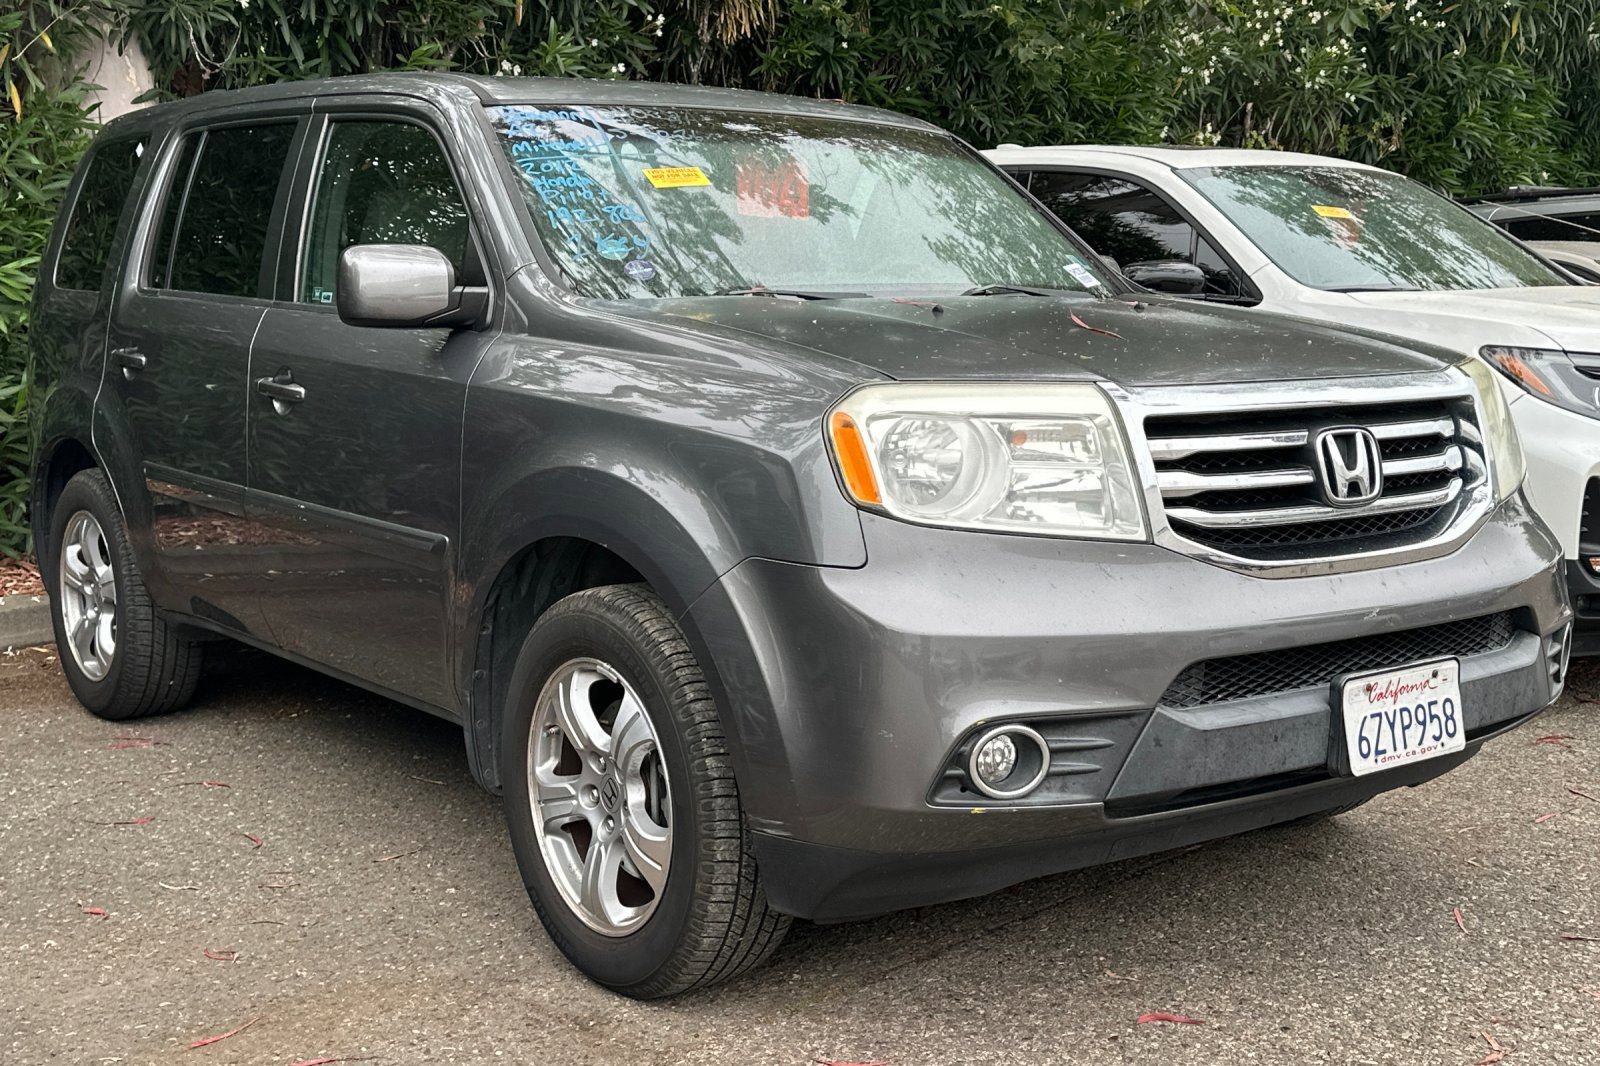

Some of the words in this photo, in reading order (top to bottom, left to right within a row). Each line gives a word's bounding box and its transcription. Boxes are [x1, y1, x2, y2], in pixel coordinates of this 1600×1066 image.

[531, 174, 594, 189] Honda
[536, 186, 612, 205] Pilot
[1367, 676, 1438, 705] California
[1357, 697, 1457, 760] 6ZYP958
[1380, 743, 1439, 764] dmv.ca.gov
